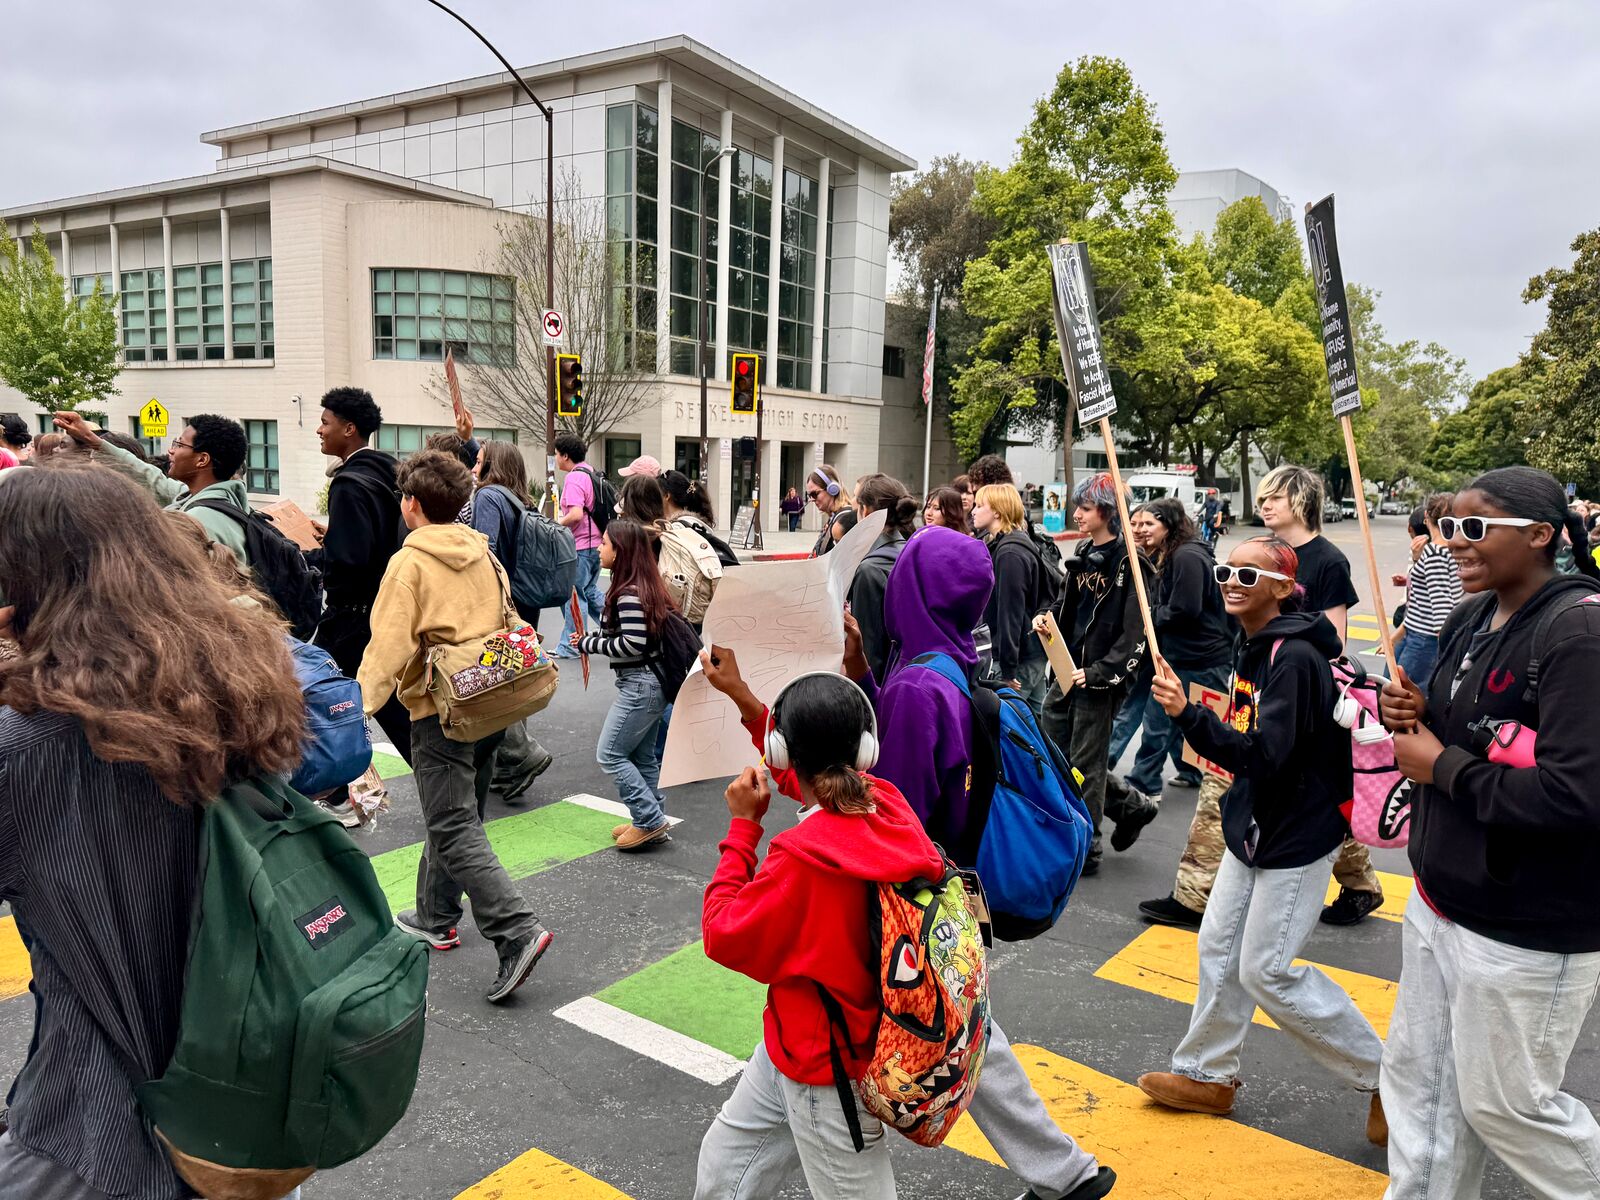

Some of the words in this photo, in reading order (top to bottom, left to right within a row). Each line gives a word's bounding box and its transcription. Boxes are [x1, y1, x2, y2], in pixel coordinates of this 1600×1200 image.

[1326, 335, 1346, 358] EFUSE
[1079, 387, 1098, 404] Fascist
[763, 409, 794, 427] HIGH
[802, 412, 849, 431] SCHOOL
[687, 614, 758, 756] RIHTS
[304, 904, 347, 940] JANSPORT
